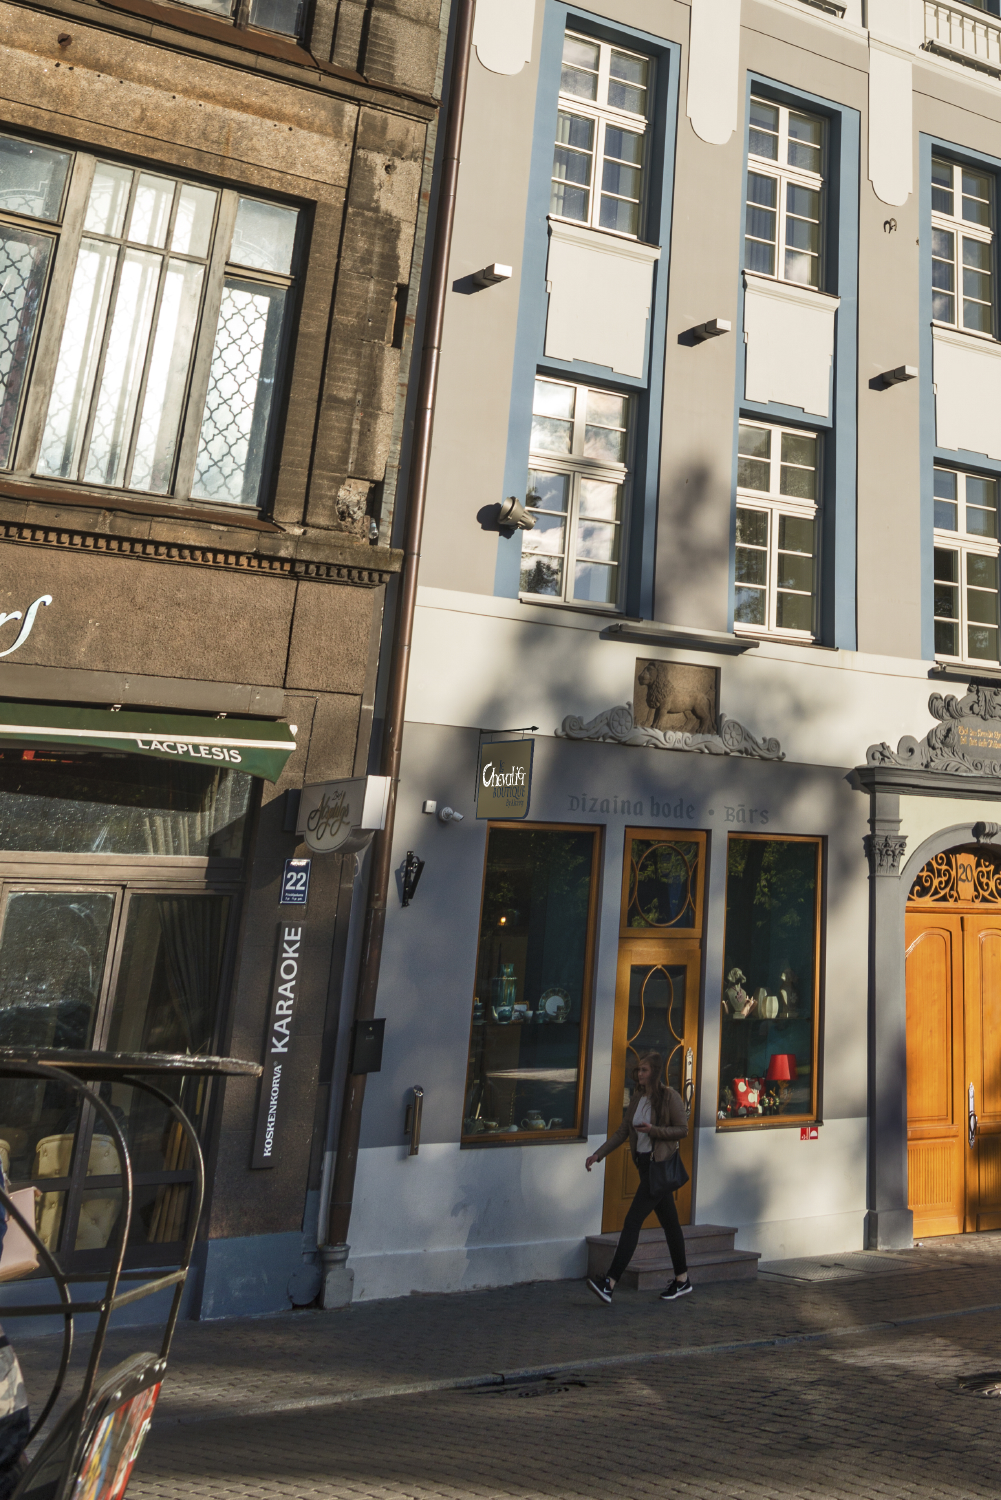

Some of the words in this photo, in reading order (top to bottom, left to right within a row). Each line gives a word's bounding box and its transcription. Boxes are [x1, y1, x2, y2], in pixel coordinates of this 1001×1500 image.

[493, 786, 526, 800] BOUTIQUE
[567, 793, 644, 816] Dizaina
[650, 796, 695, 819] bode
[724, 804, 769, 825] Bārs
[285, 872, 306, 890] 22
[958, 863, 973, 883] 20
[271, 927, 302, 1053] KARAOKE
[263, 1064, 282, 1157] KOSKENKORVA
